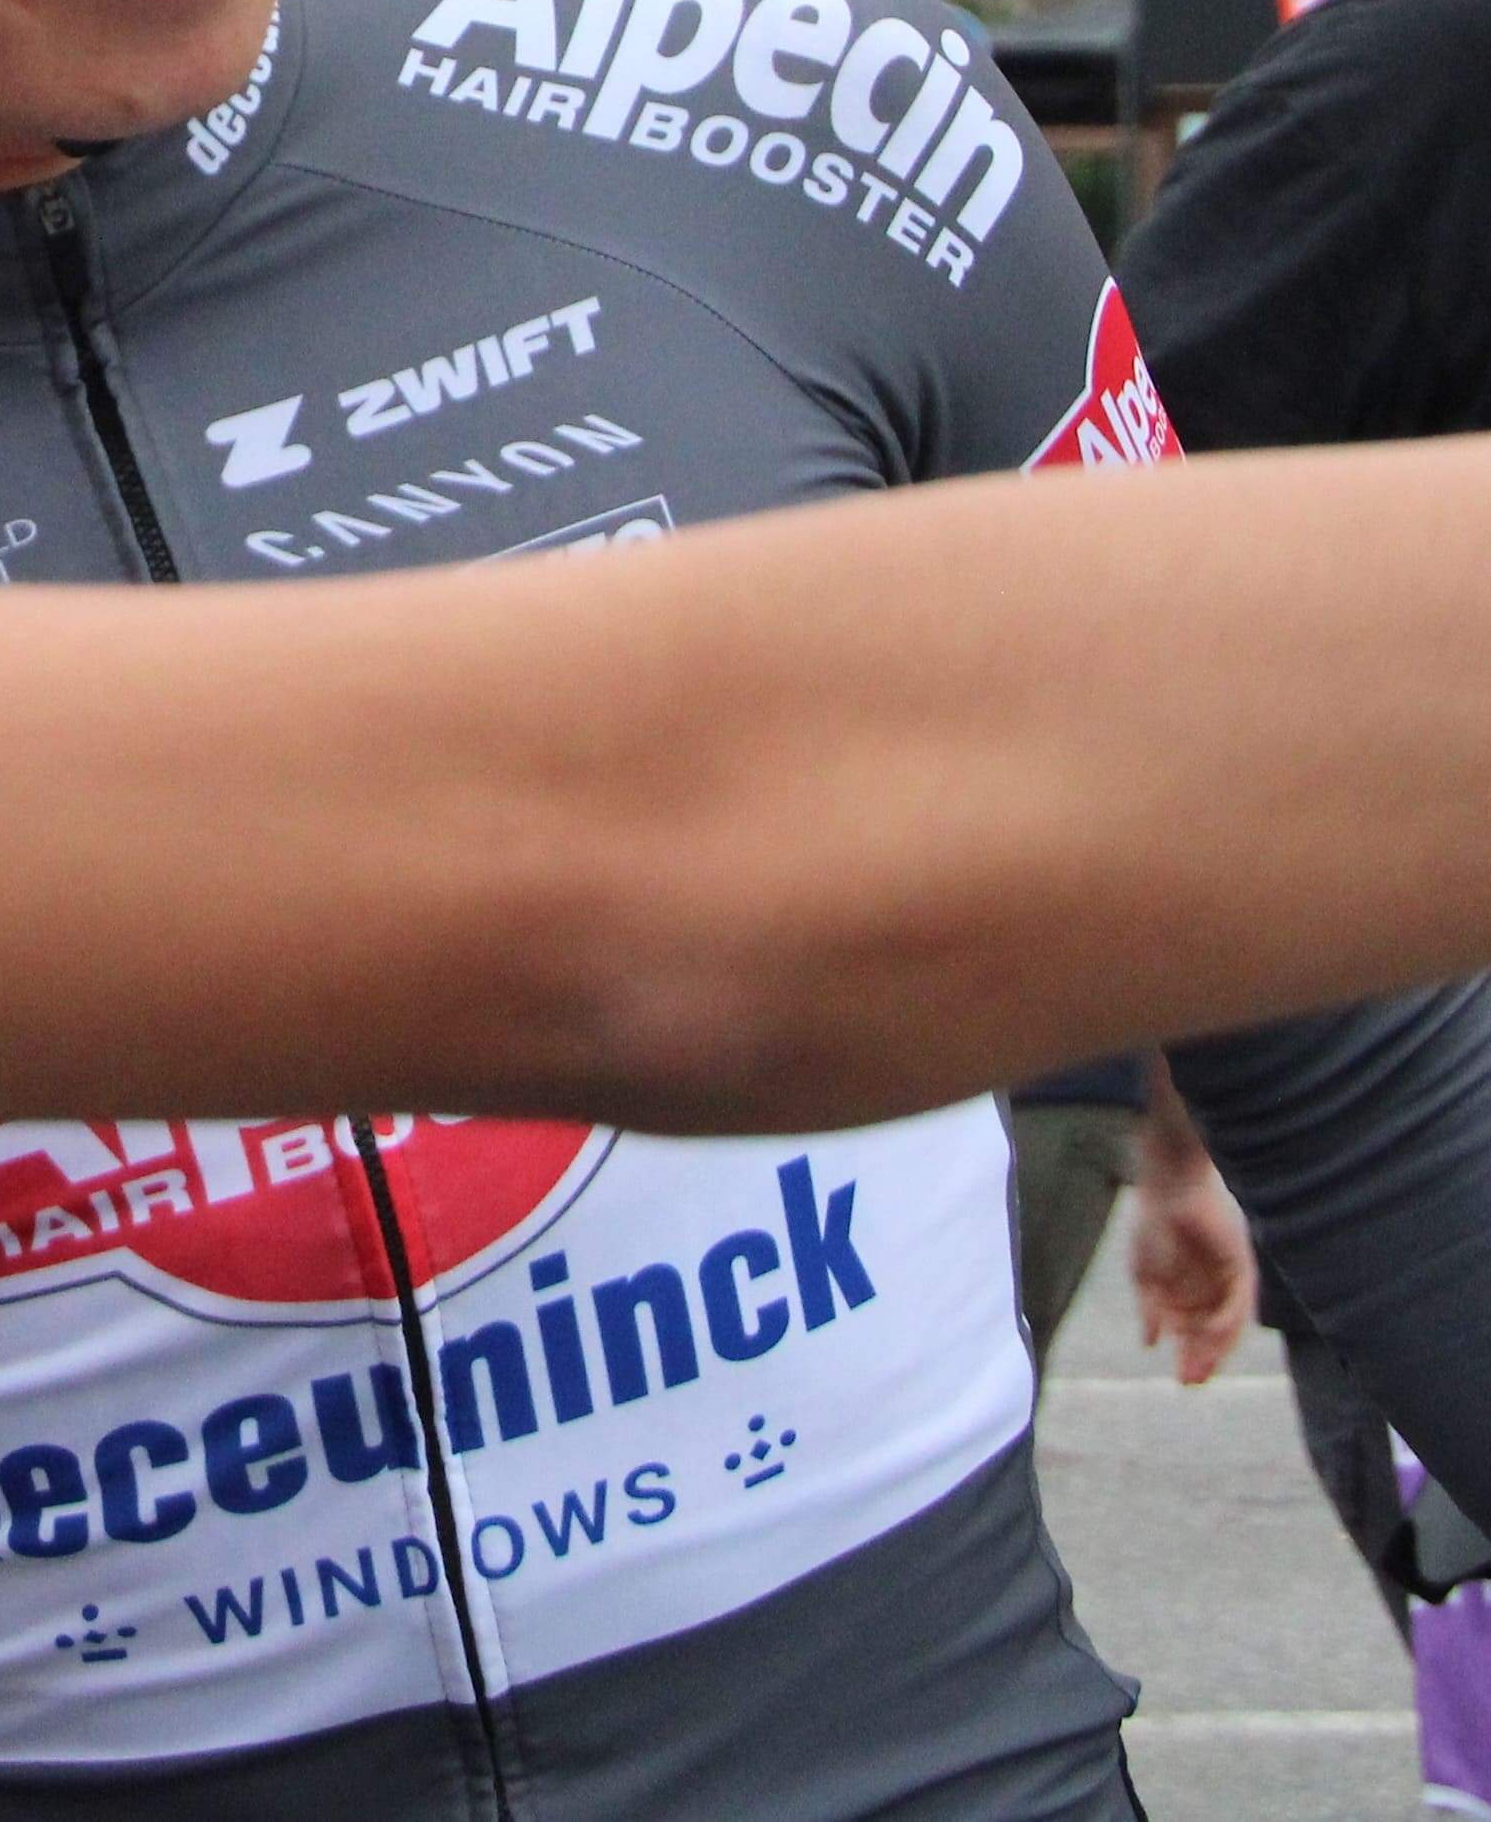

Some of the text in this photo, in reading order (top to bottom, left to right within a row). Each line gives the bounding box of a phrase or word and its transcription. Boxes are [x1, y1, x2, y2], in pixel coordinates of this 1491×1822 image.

[397, 48, 976, 289] HAIR BOOSTER
[336, 295, 602, 441] ZWIFT
[244, 413, 644, 567] CANYON
[185, 1462, 678, 1647] WINDOWS
